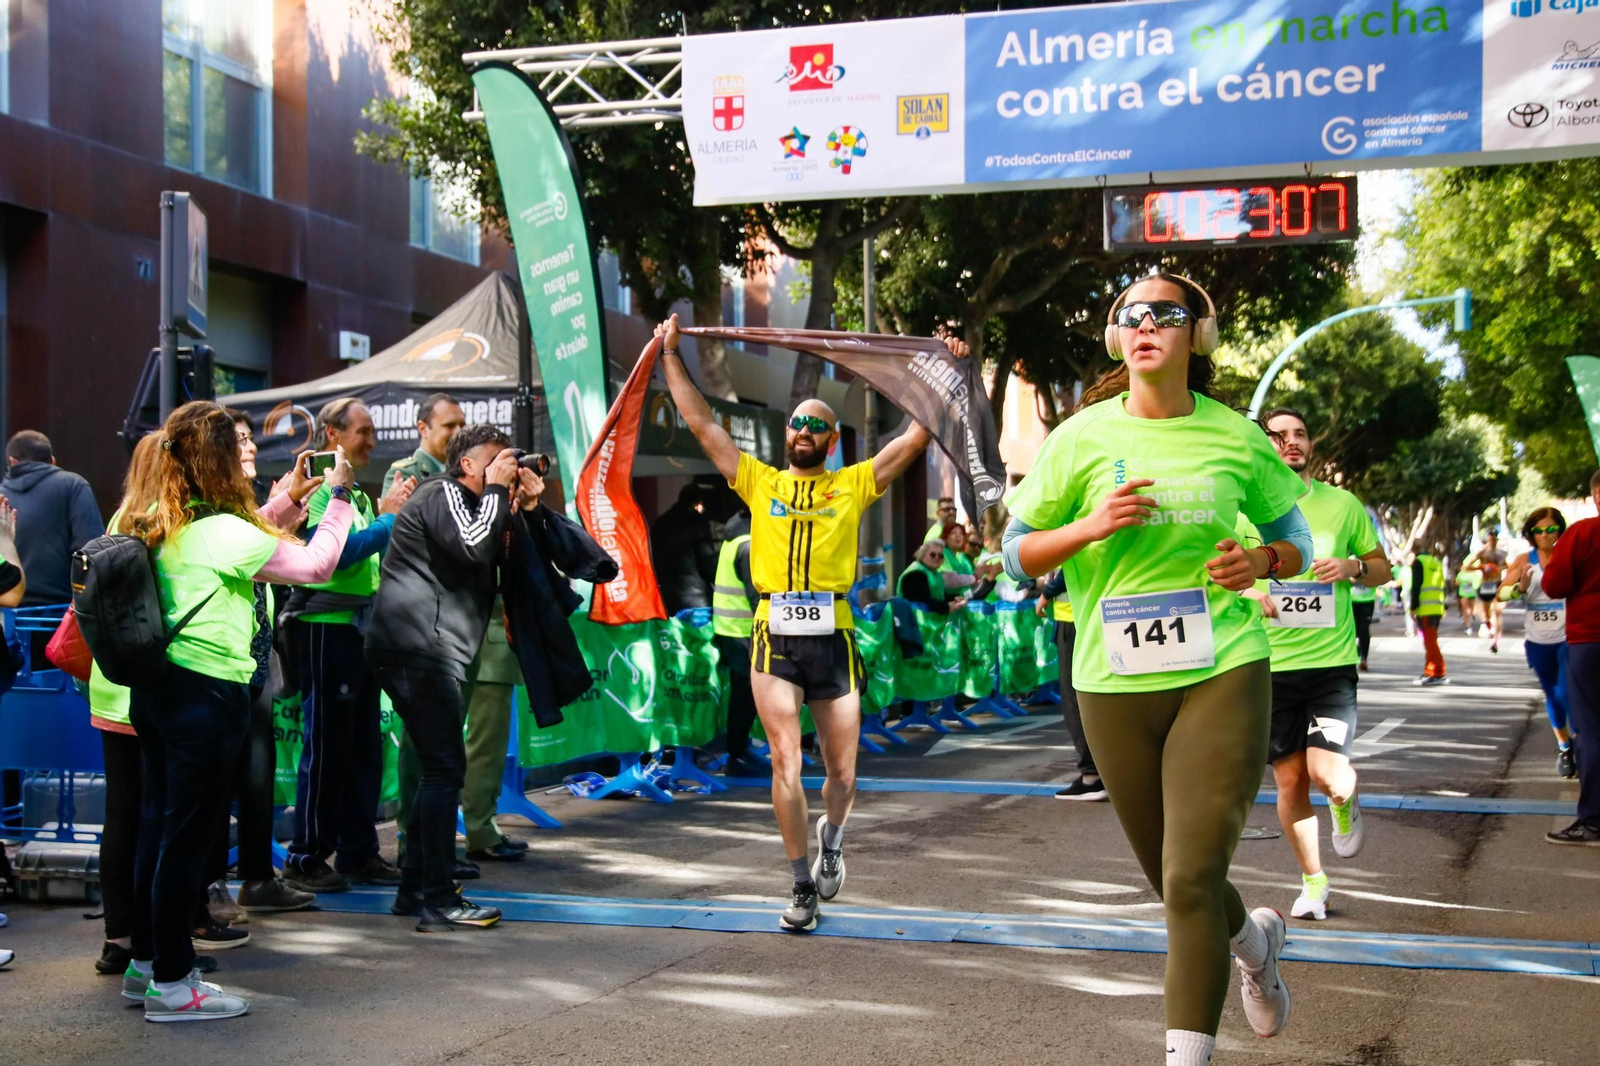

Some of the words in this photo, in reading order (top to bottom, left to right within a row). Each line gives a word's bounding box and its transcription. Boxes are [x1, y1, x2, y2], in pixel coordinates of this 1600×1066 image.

[996, 20, 1174, 67] Almería
[1190, 22, 1245, 50] en
[1265, 0, 1448, 45] marcha
[996, 77, 1144, 118] contra
[1158, 67, 1203, 106] el
[1216, 63, 1385, 102] cáncer
[903, 97, 943, 115] SOLAN
[1557, 98, 1600, 111] Toyot
[1362, 114, 1419, 127] asociación
[1421, 110, 1468, 124] española
[1364, 127, 1398, 137] contra
[1399, 125, 1409, 135] el
[1411, 123, 1446, 134] cáncer
[697, 137, 758, 155] ALMERÍA
[1364, 139, 1379, 149] en
[984, 148, 1132, 167] #TodosContraElCáncer
[801, 163, 818, 171] 2005
[1143, 488, 1194, 503] ontra
[1199, 487, 1216, 502] el
[1105, 607, 1127, 616] contra
[1136, 605, 1160, 613] cáncer
[1281, 596, 1322, 612] 264
[782, 605, 821, 621] 398
[1533, 611, 1558, 622] 835
[1123, 616, 1186, 648] 141
